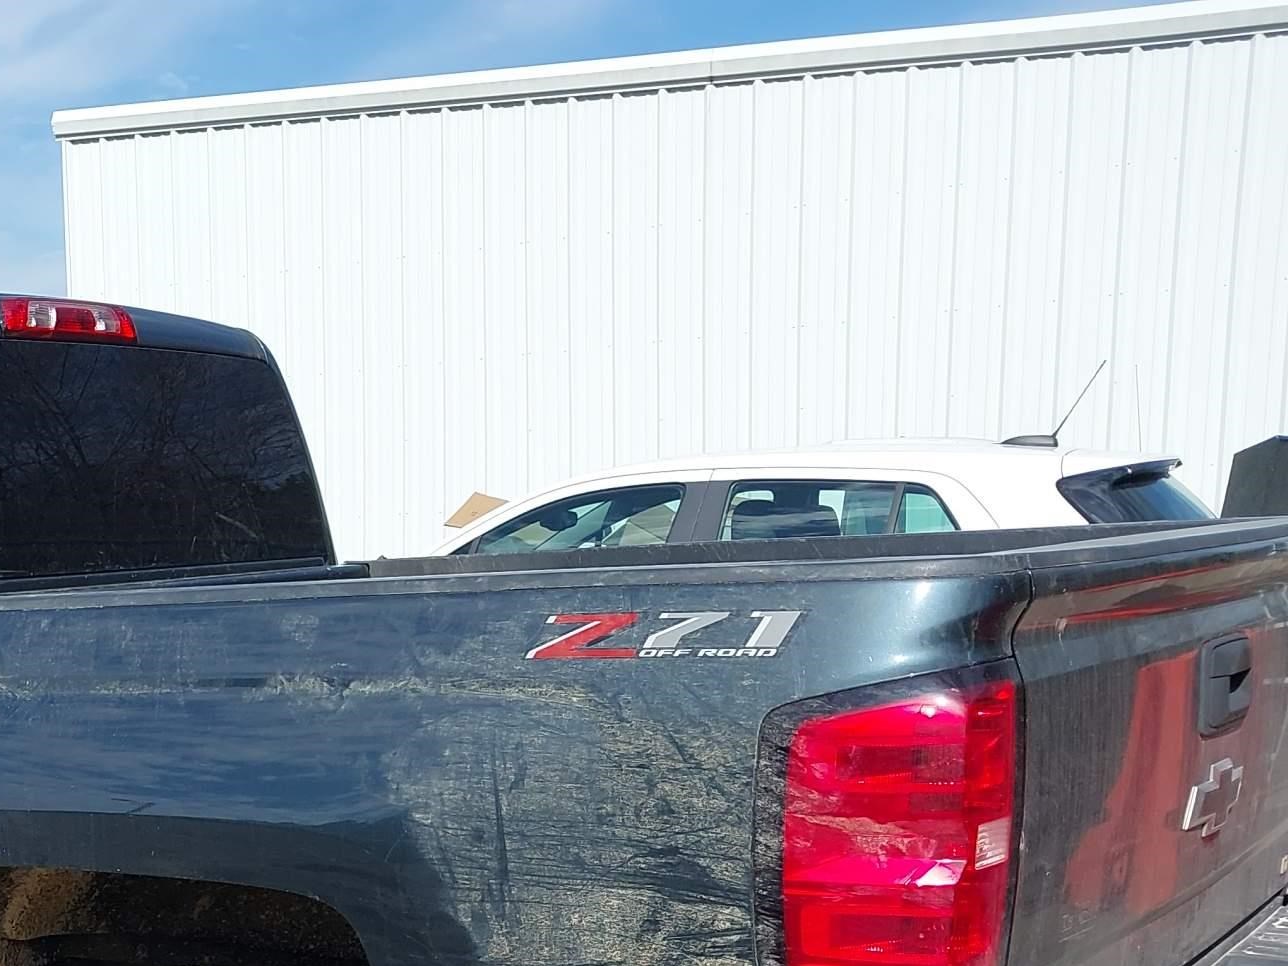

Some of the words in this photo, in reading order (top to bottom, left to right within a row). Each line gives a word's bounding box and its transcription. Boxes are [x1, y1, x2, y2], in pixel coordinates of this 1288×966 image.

[525, 611, 801, 659] Z71
[638, 648, 692, 658] OFF
[697, 648, 778, 658] ROAD
